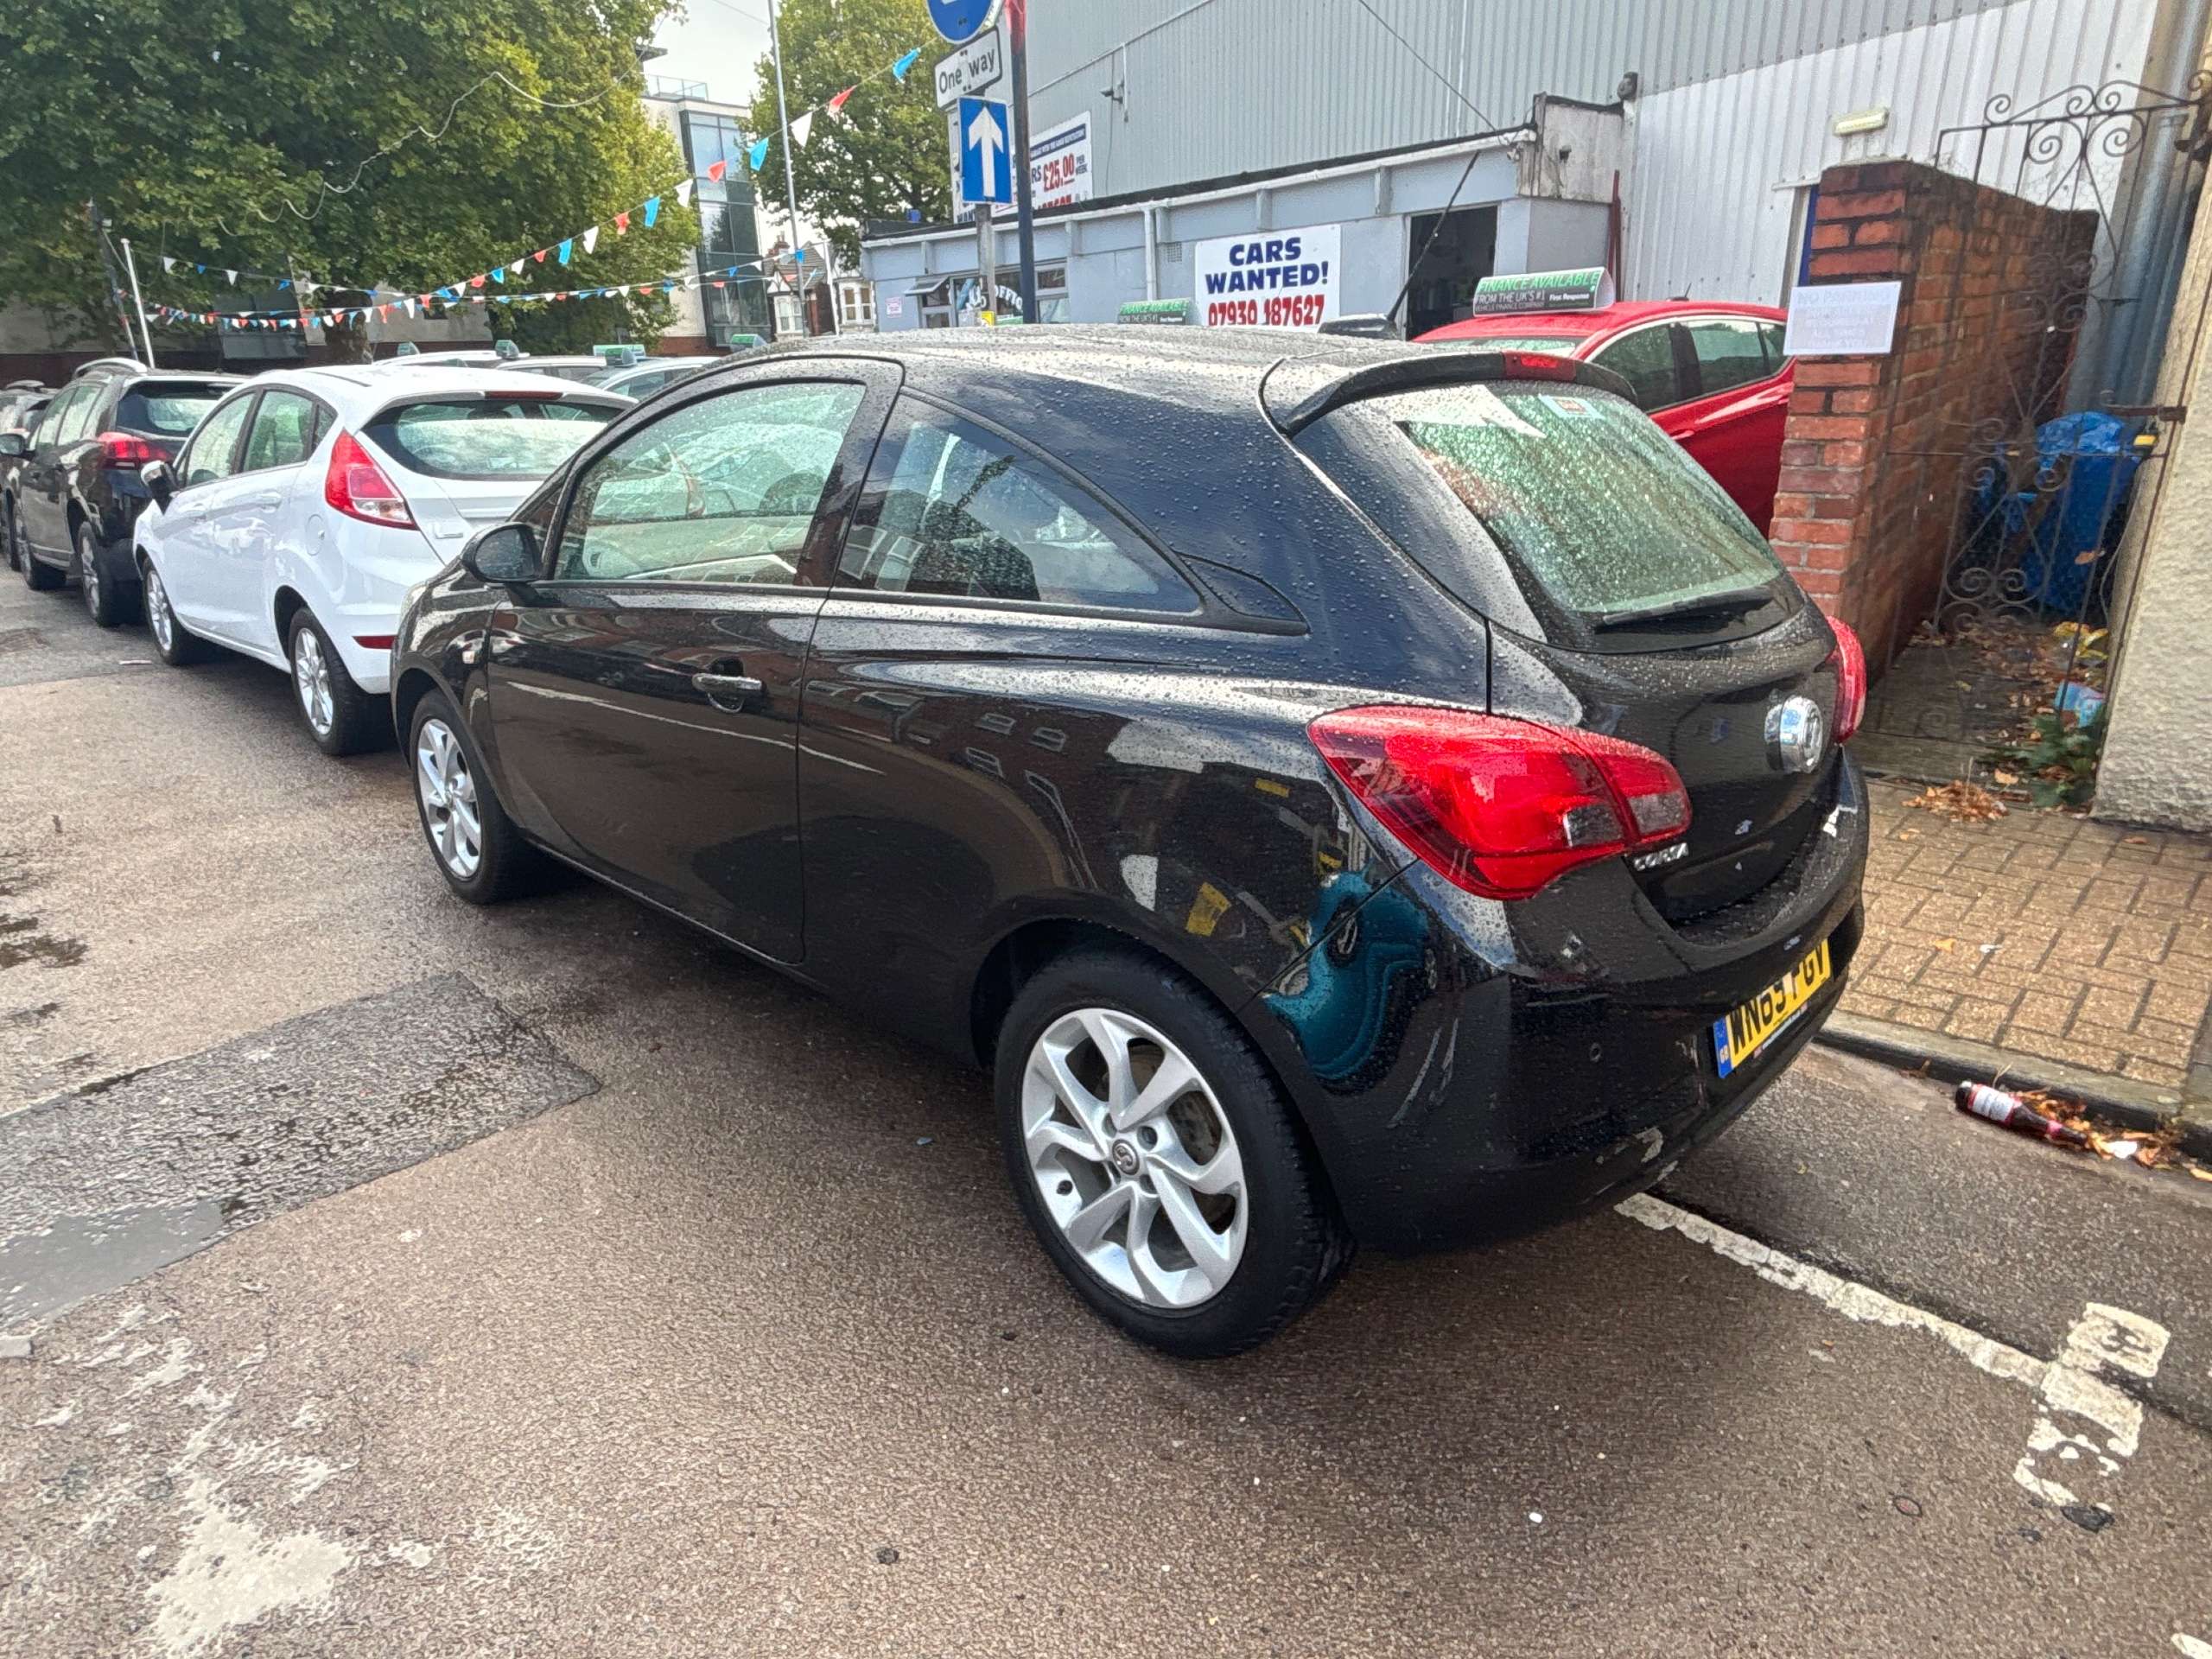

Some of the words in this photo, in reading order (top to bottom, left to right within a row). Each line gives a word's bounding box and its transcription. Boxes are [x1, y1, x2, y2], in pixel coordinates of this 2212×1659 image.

[939, 68, 962, 94] One
[969, 48, 995, 78] way
[1043, 153, 1074, 192] £25.00
[1229, 237, 1301, 266] CARS
[1205, 261, 1329, 295] WANTED!
[1479, 278, 1530, 292] FINANCE
[1530, 271, 1599, 289] AVAILABLE
[1208, 298, 1258, 327] 07930
[1263, 294, 1325, 327] 187627
[1498, 292, 1515, 303] THE
[1515, 289, 1535, 302] UK'S
